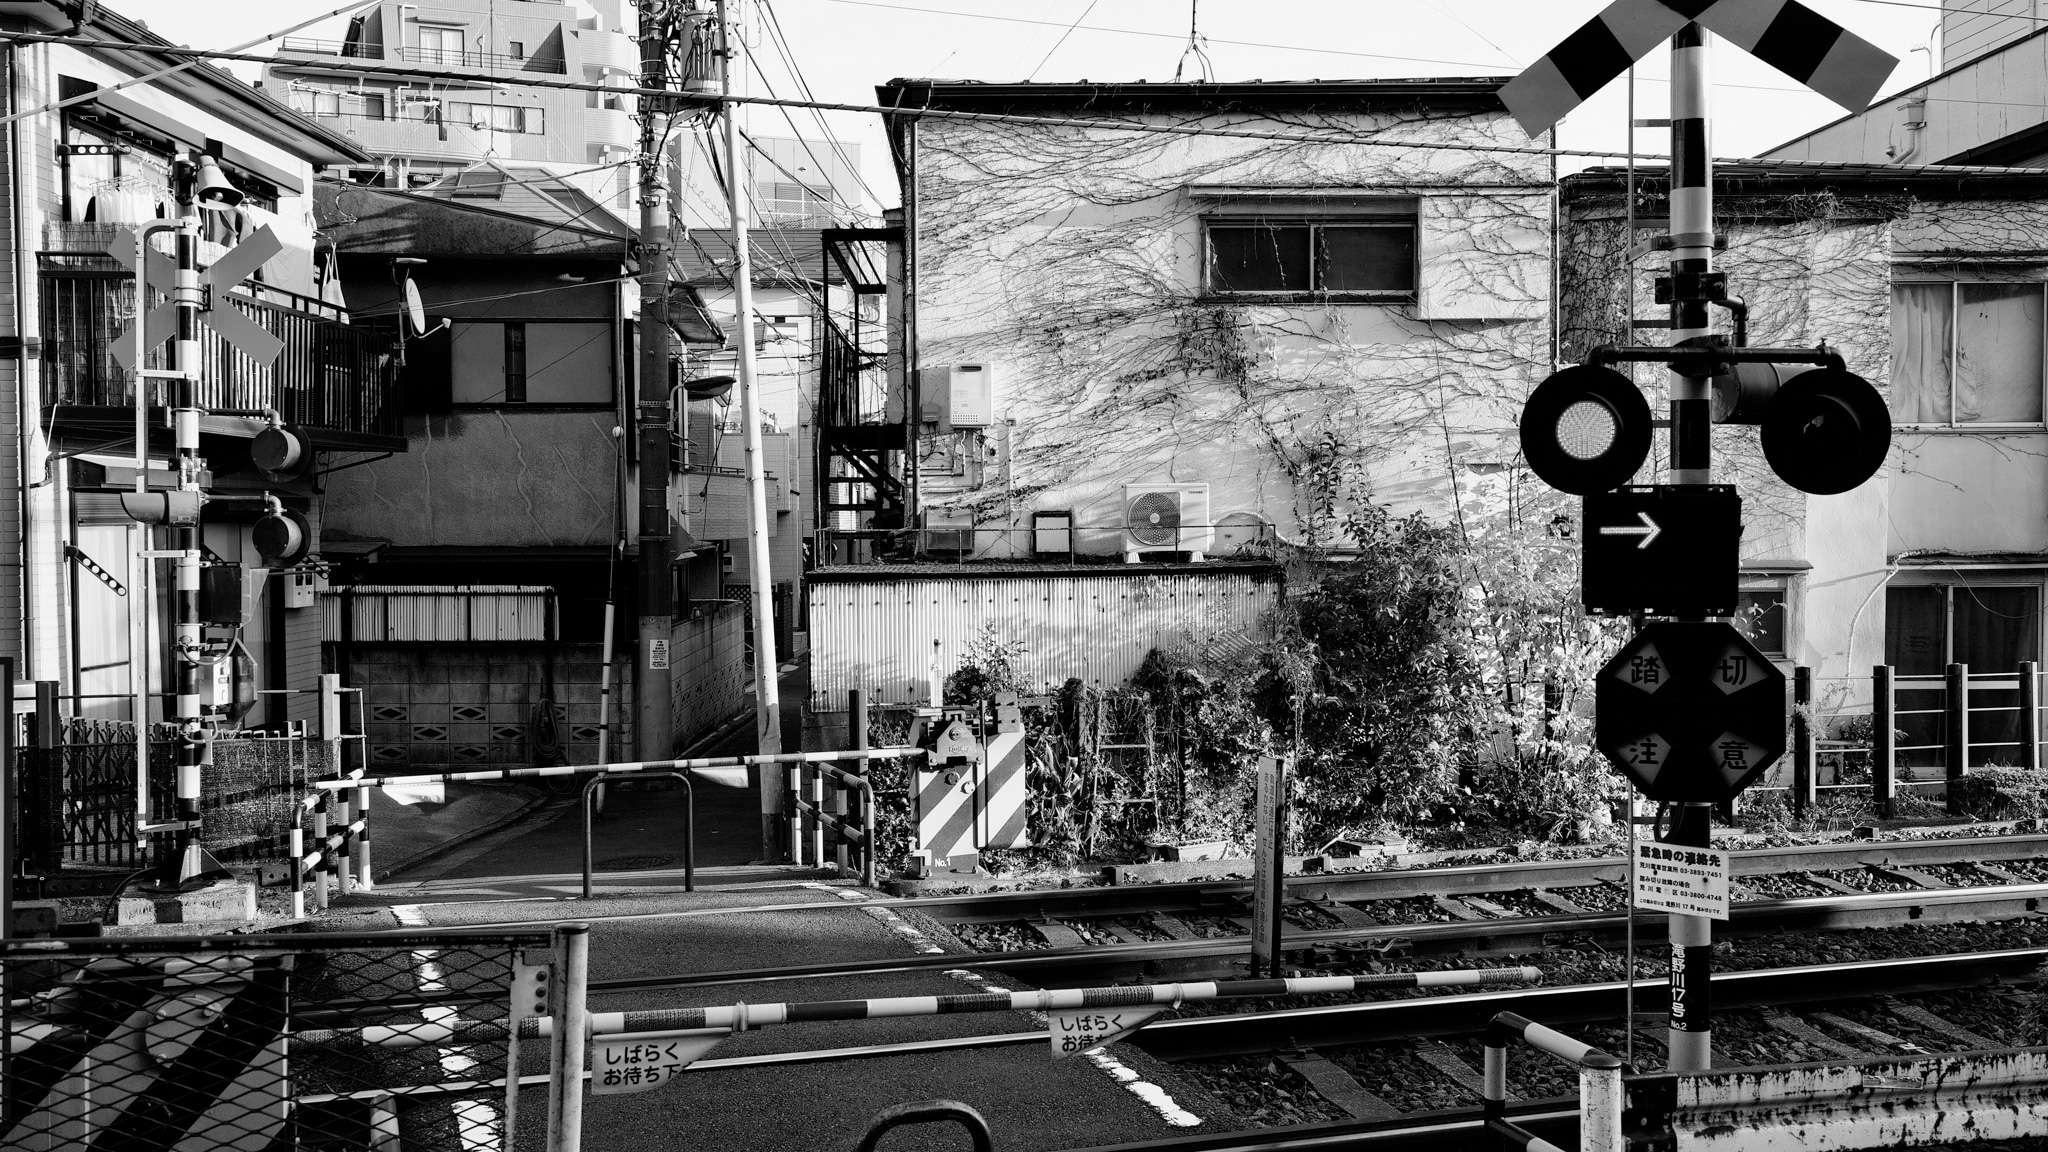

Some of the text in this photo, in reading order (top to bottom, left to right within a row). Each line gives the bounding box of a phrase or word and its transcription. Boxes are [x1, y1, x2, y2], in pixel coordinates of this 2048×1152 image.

[1631, 655, 1748, 685] 踏 切
[1629, 737, 1749, 770] 注 意
[934, 857, 951, 867] No.1
[1640, 845, 1721, 867] 緊急時の連絡先
[1680, 867, 1722, 878] 03-3893-7451
[1671, 943, 1686, 1018] 滝野川17号
[1060, 1014, 1124, 1031] しばらく
[1670, 1019, 1687, 1031] No.2
[606, 1042, 679, 1065] しばらく
